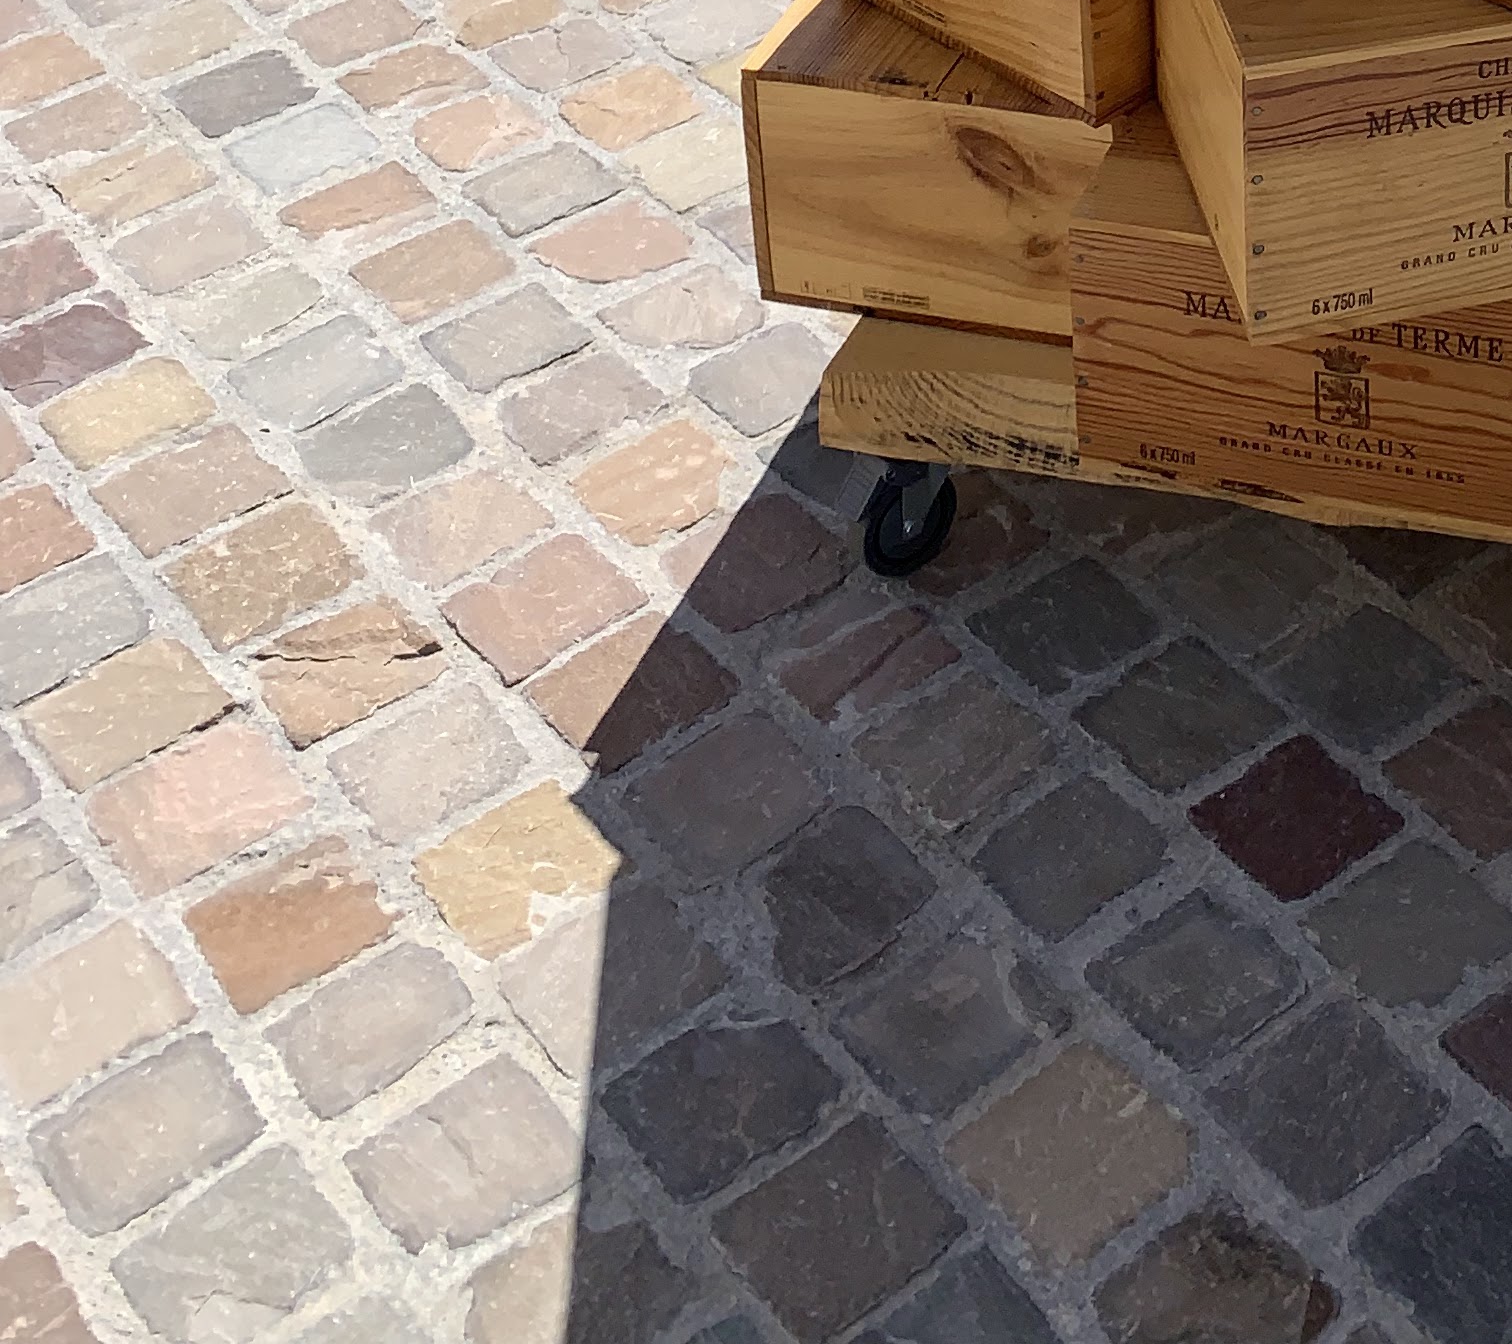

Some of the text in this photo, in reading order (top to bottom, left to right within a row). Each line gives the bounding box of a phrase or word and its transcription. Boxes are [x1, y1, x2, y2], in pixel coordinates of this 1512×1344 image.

[1400, 250, 1456, 271] GRAND
[1467, 242, 1500, 258] CRU
[1391, 322, 1504, 363] TERME
[1265, 420, 1418, 460] MARGAUX
